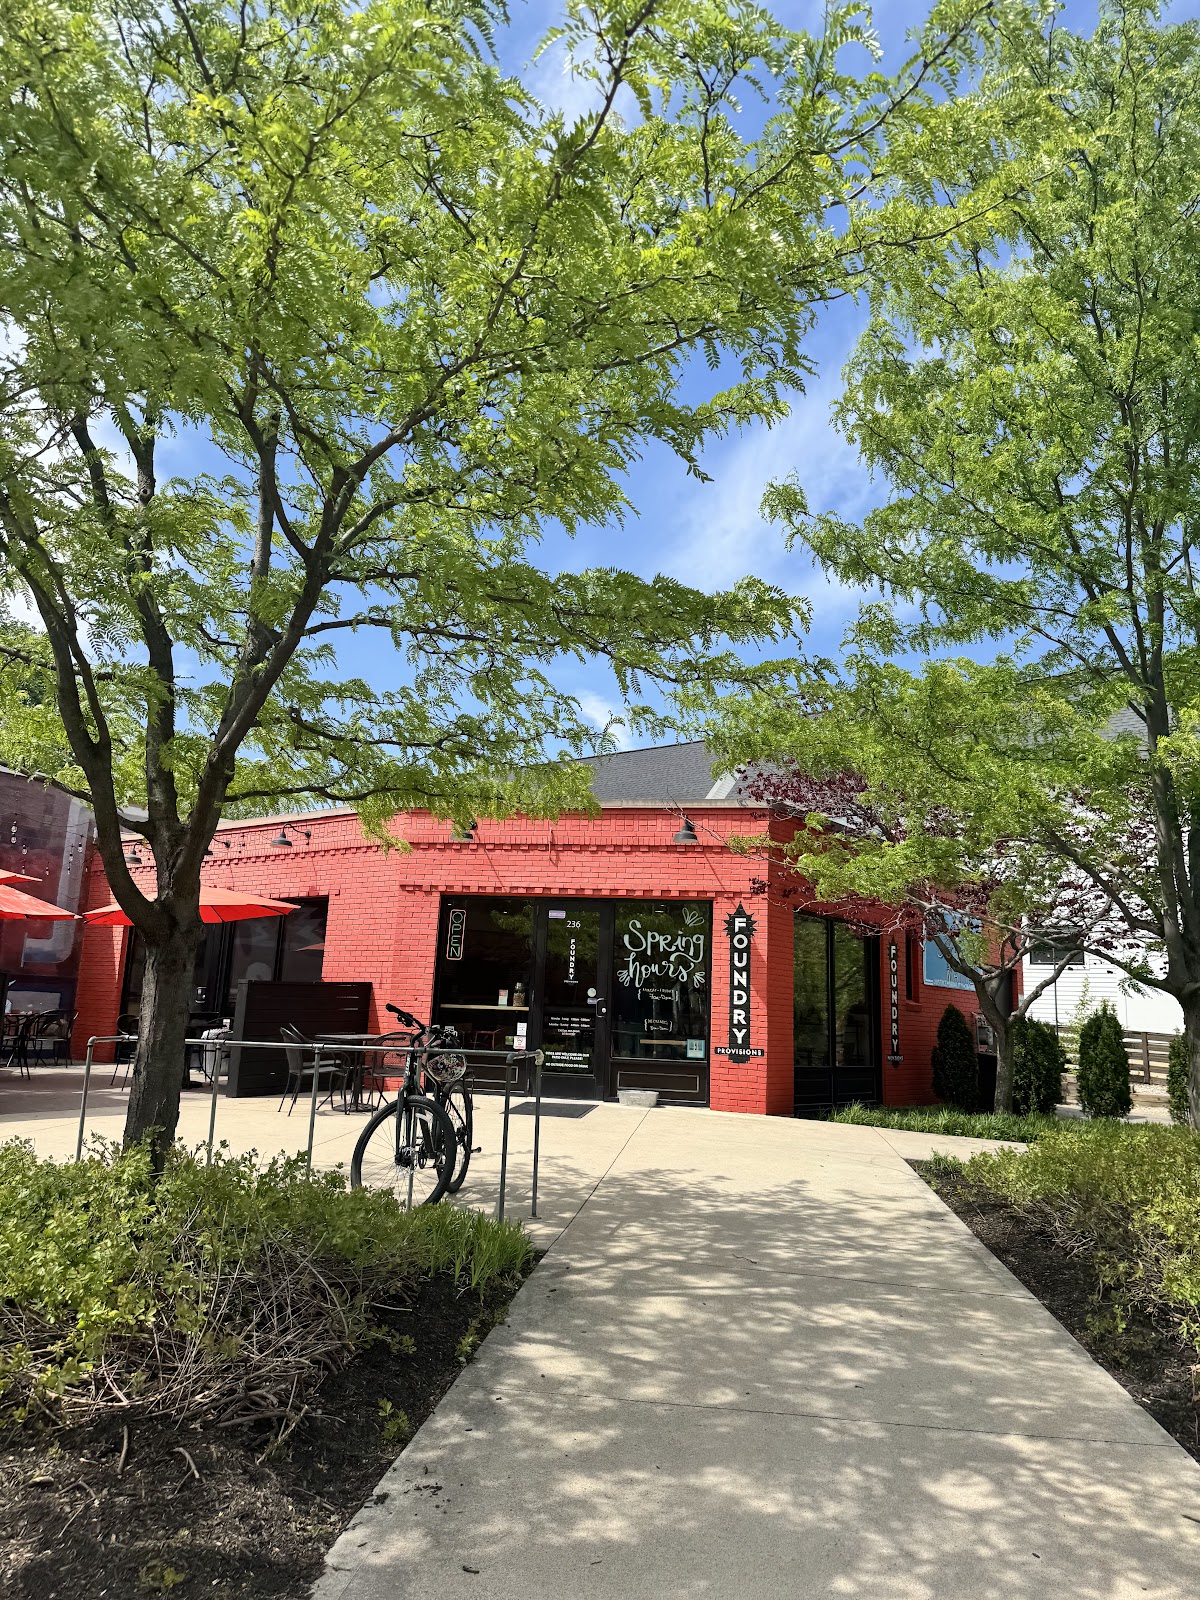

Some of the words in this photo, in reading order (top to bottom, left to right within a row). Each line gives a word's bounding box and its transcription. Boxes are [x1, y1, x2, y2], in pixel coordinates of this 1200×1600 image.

[450, 912, 463, 957] OPEN
[624, 952, 695, 988] hours
[733, 917, 748, 1044] FOUNDRY
[890, 945, 898, 1052] FOUNDRY
[717, 1047, 762, 1056] PROVISIONS
